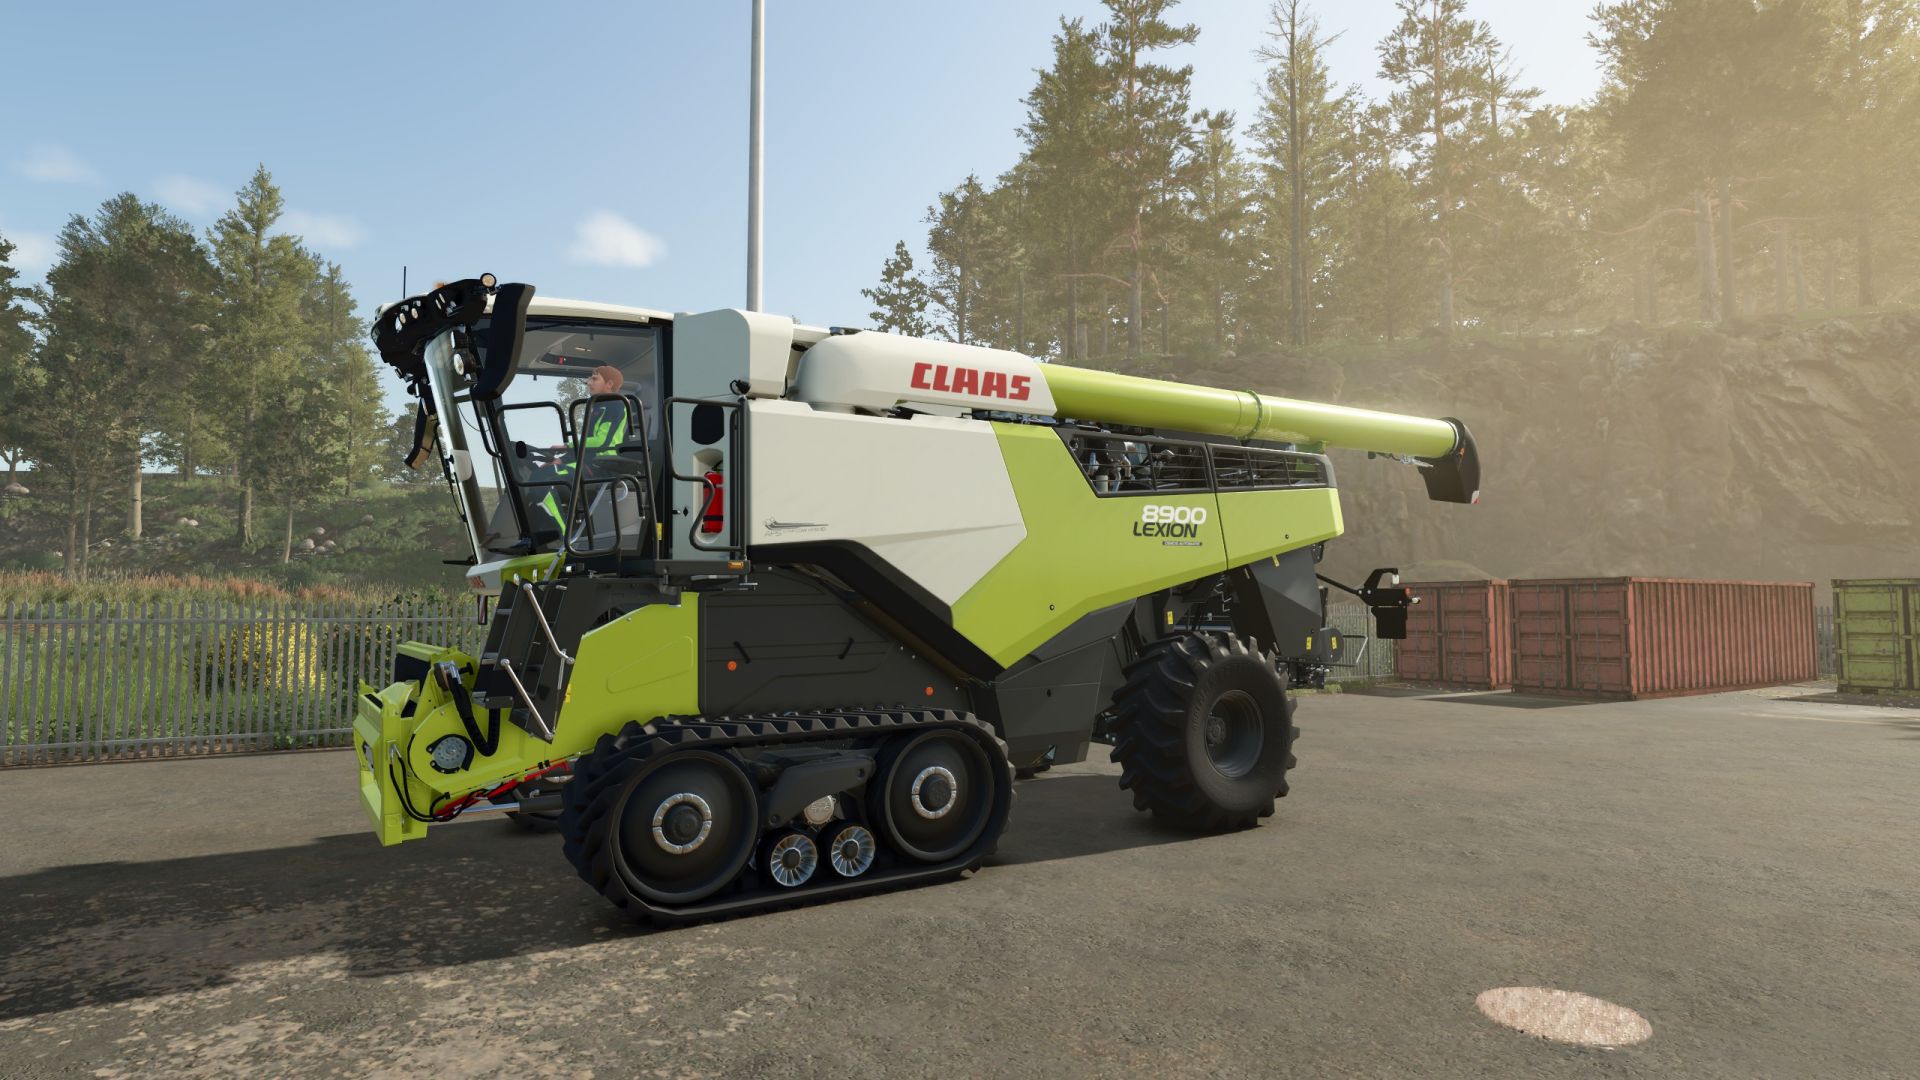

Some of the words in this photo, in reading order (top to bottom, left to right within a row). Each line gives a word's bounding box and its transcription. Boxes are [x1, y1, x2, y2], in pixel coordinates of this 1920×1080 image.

[910, 362, 1031, 401] CLAAS
[1141, 504, 1207, 525] 8900
[1133, 521, 1198, 538] LEXION
